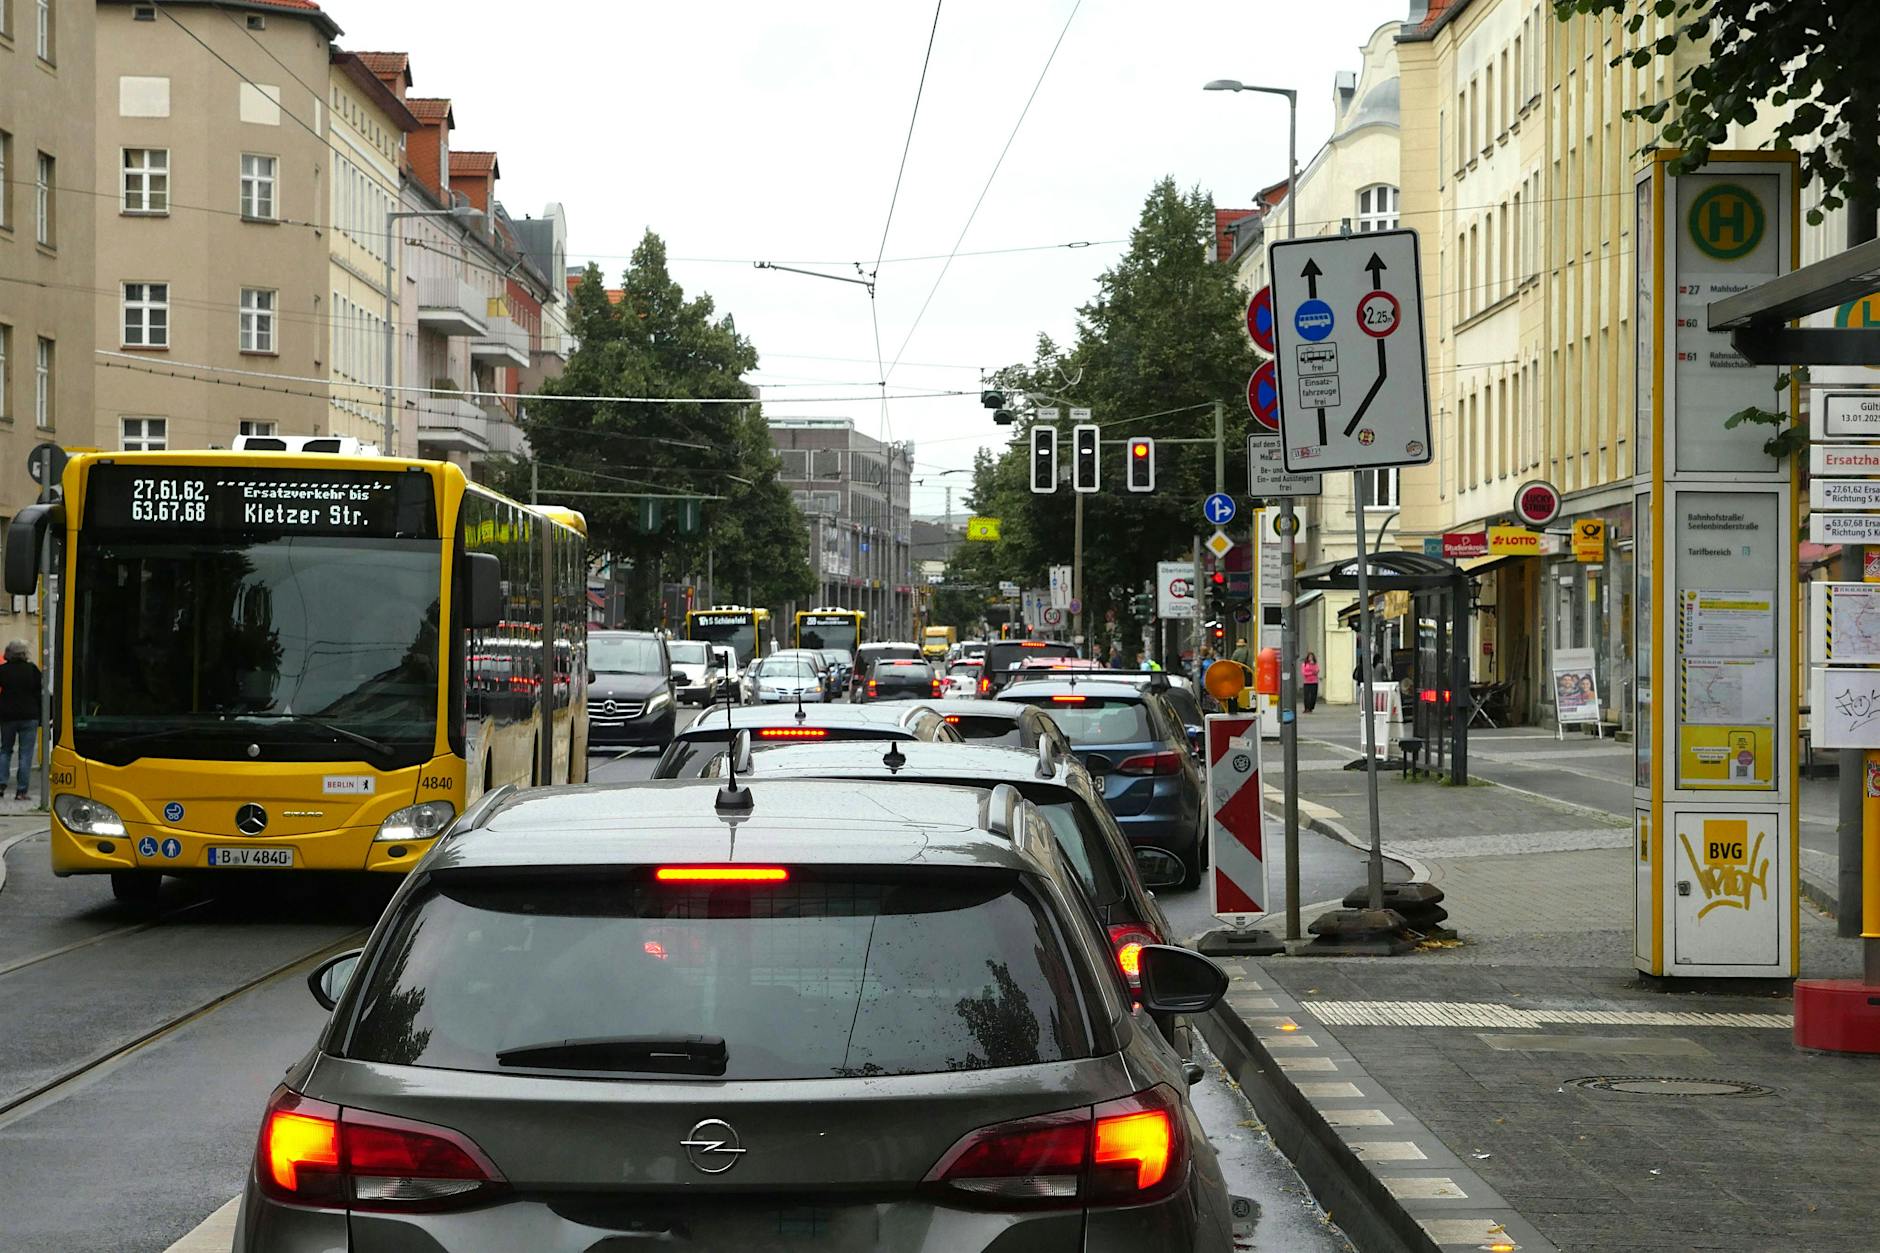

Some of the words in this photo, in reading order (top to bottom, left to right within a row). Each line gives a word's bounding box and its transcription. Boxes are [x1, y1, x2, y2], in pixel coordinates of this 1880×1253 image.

[1709, 201, 1744, 242] H
[1689, 285, 1700, 295] 27
[1686, 319, 1698, 328] 60
[1305, 378, 1333, 386] Einsatz-
[1302, 388, 1337, 397] fahrzeuge
[1860, 402, 1880, 411] Gülti
[1826, 453, 1880, 465] Ersatzha
[133, 480, 210, 501] 27,61,62,
[243, 487, 346, 500] Ersatzverkehr
[349, 489, 370, 501] bis
[1864, 486, 1880, 494] Ersa
[1832, 495, 1866, 504] Richtung
[132, 502, 206, 522] 63,67,68
[244, 503, 320, 525] Kietzer
[329, 505, 369, 526] Str.
[1865, 519, 1880, 527] Ersa
[1831, 529, 1866, 538] Richtung
[1506, 536, 1537, 545] LOTTO
[1688, 548, 1732, 556] Tarifbereich
[327, 780, 355, 789] BERLIN
[421, 776, 453, 790] 4840
[1709, 842, 1743, 859] BVG
[222, 853, 231, 864] B
[241, 853, 249, 864] V
[253, 852, 288, 864] 4840
